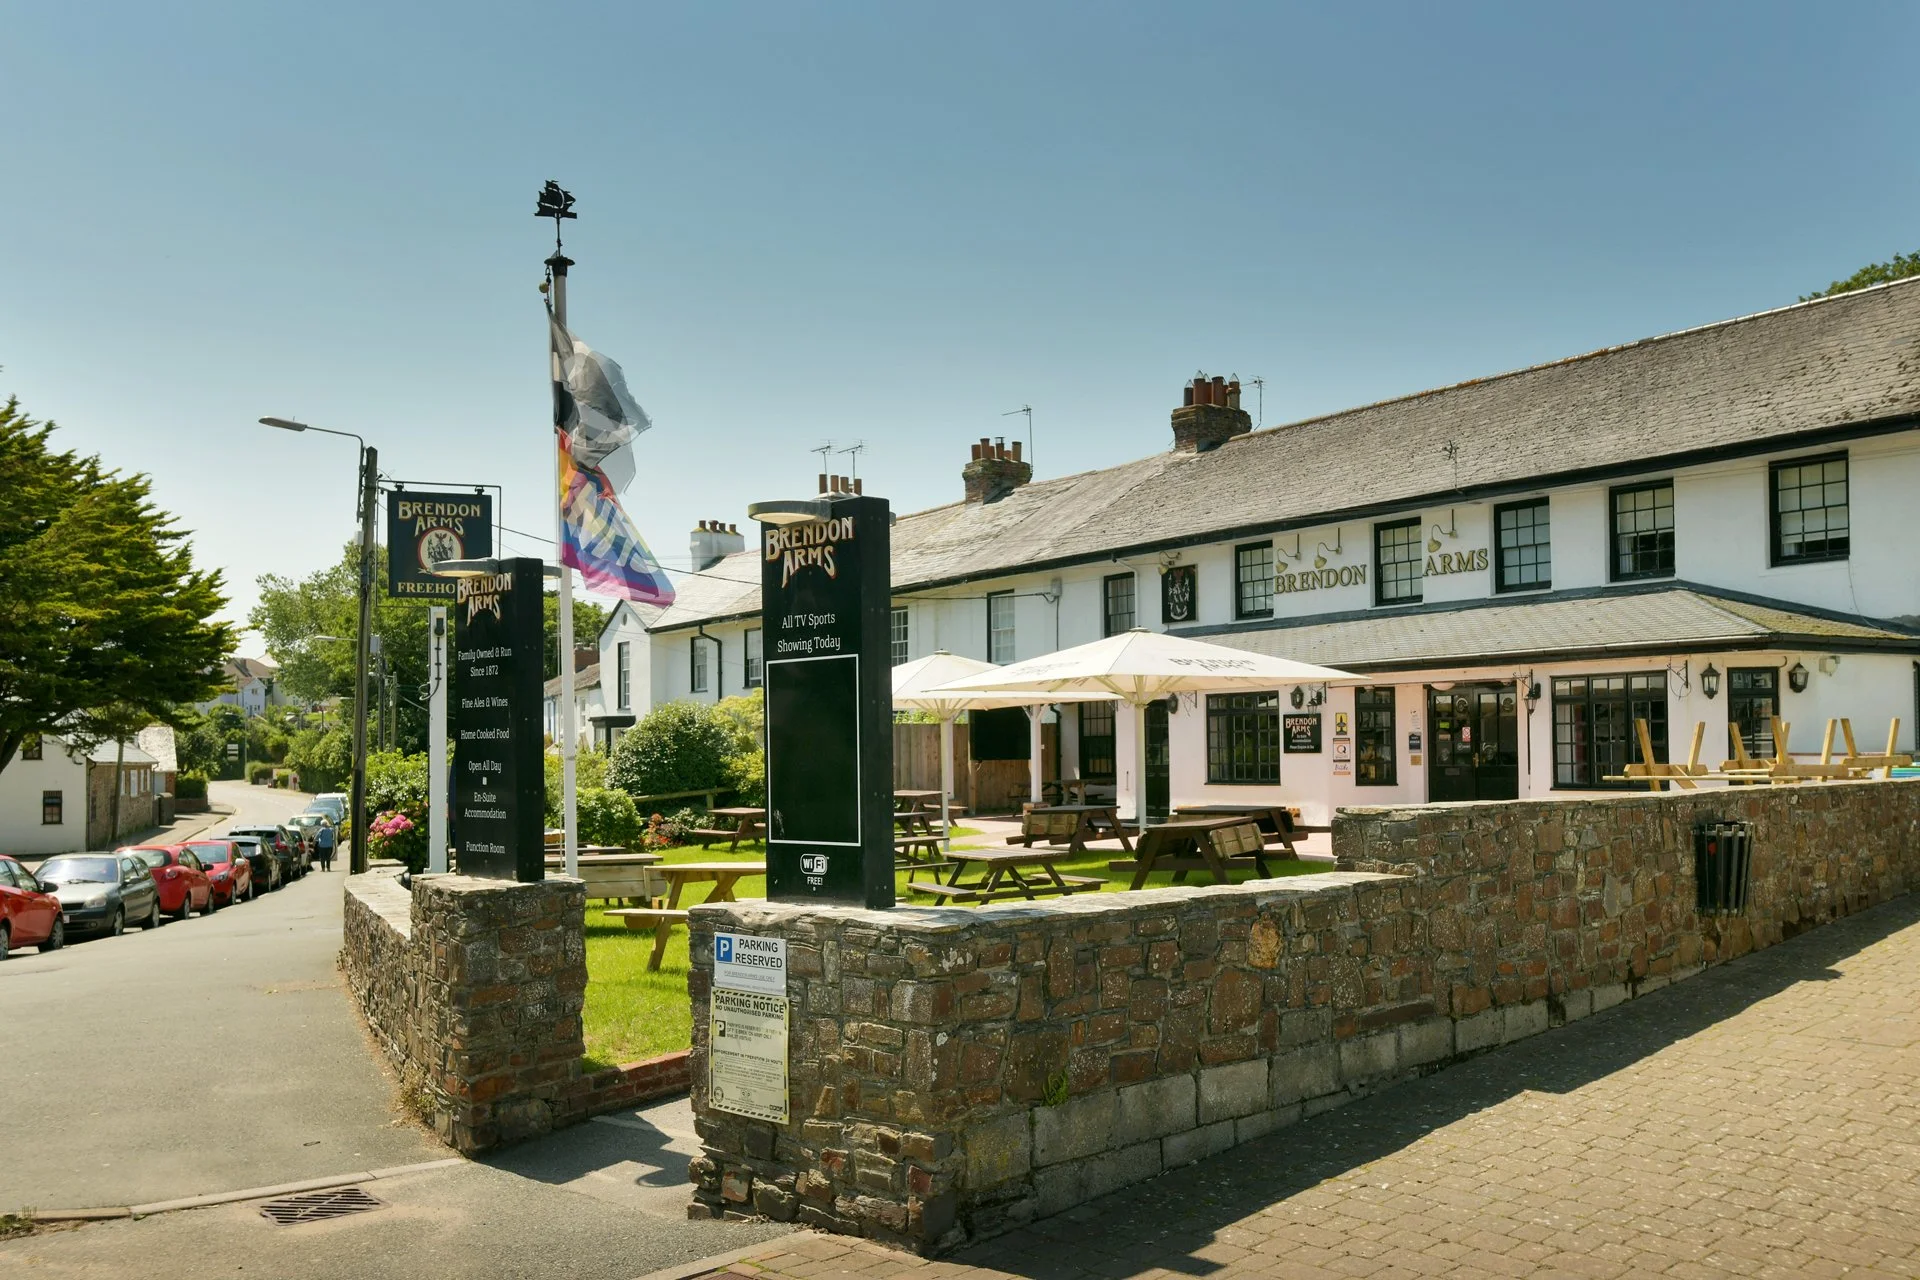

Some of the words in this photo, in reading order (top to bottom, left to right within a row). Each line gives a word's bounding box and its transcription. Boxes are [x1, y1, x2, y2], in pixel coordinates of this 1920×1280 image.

[398, 501, 480, 519] BRENDON
[415, 516, 464, 536] ARMS
[765, 516, 853, 562] BRENDON
[782, 545, 837, 588] ARMS
[1274, 564, 1367, 594] BRENDON
[1423, 548, 1489, 577] ARMS
[397, 582, 455, 594] FREEHO
[457, 572, 512, 604] BRENDON
[466, 594, 501, 627] ARMS
[782, 616, 793, 629] All
[794, 614, 807, 628] TV
[808, 612, 836, 629] Sports
[777, 638, 813, 654] Showing
[813, 634, 841, 650] Today
[457, 649, 476, 662] Family
[476, 646, 494, 659] Owned
[500, 646, 512, 657] Run
[470, 666, 485, 677] Since
[485, 665, 499, 676] 1872
[461, 698, 473, 708] Fine
[473, 697, 485, 708] Ales
[491, 696, 508, 707] Wines
[1285, 717, 1317, 729] BRENDON
[460, 730, 476, 740] Home
[476, 728, 495, 739] Cooked
[496, 727, 509, 739] Food
[1291, 726, 1311, 738] ARMS
[468, 761, 482, 773] Open
[482, 760, 490, 771] All
[490, 761, 502, 773] Day
[473, 791, 496, 803] En-Suite
[464, 808, 507, 819] Accommodation
[466, 841, 489, 853] Function
[489, 842, 505, 854] Room
[720, 939, 730, 958] P
[739, 938, 778, 953] PARKING
[735, 953, 782, 968] RESERVED
[715, 995, 751, 1010] PARKING
[753, 1000, 784, 1014] NOTICE
[724, 1006, 761, 1017] UNAUTHORISED
[762, 1011, 784, 1020] PARKING
